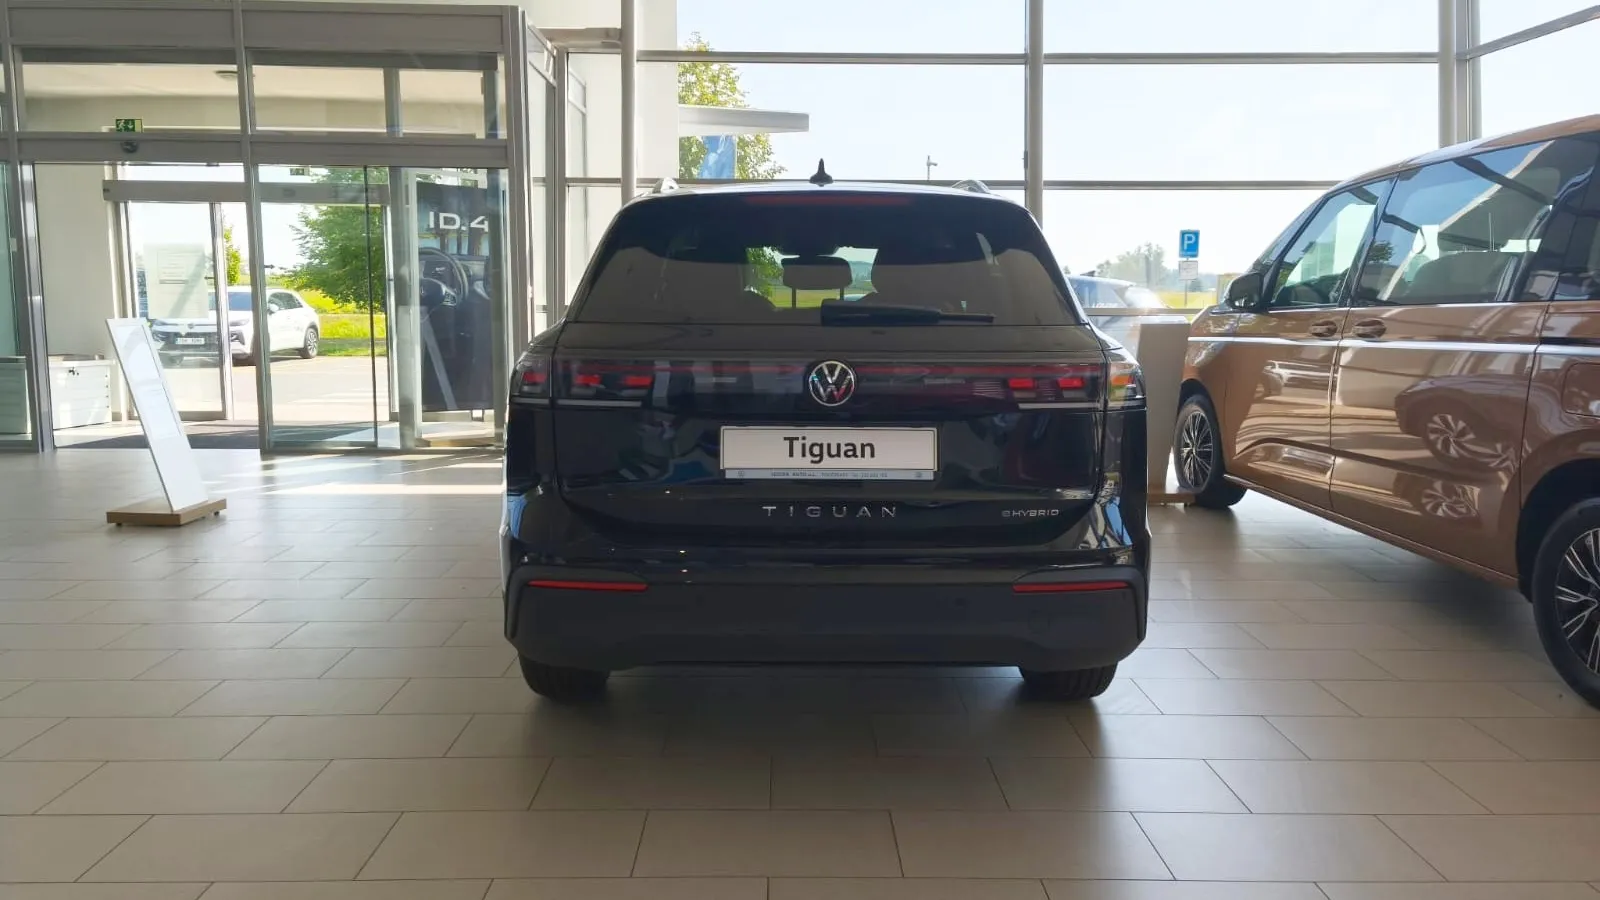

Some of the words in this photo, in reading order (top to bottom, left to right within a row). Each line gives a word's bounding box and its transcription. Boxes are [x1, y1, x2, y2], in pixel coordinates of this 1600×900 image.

[429, 211, 489, 233] ID.4
[1183, 233, 1196, 250] P
[783, 436, 876, 464] Tiguan
[762, 505, 897, 518] TIGUAN
